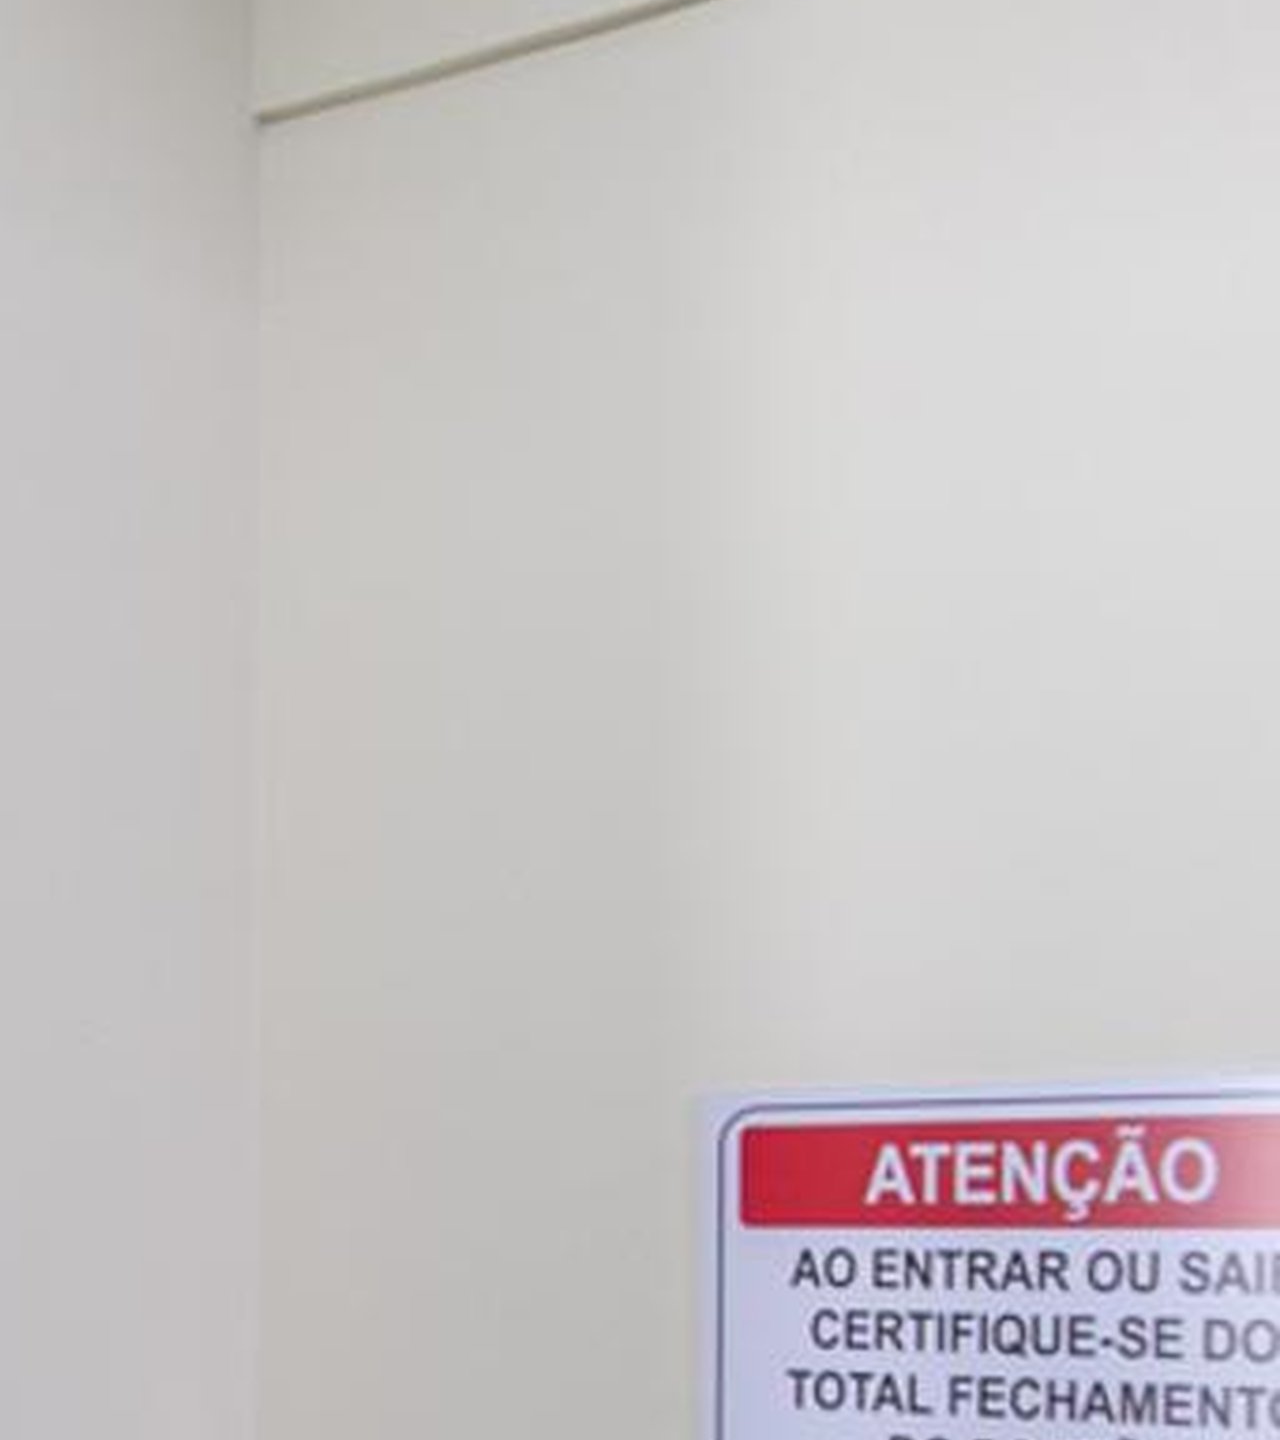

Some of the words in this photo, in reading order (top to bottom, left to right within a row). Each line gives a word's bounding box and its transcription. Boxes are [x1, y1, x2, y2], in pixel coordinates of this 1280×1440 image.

[865, 1125, 1219, 1220] ATENÇÃO
[790, 1248, 857, 1288] AO
[872, 1249, 1069, 1292] ENTRAR
[1088, 1250, 1160, 1293] OU
[1180, 1251, 1280, 1295] SAI
[810, 1309, 1183, 1360] CERTIFIQUE-SE
[1204, 1318, 1280, 1362] DO
[788, 1369, 931, 1416] TOTAL
